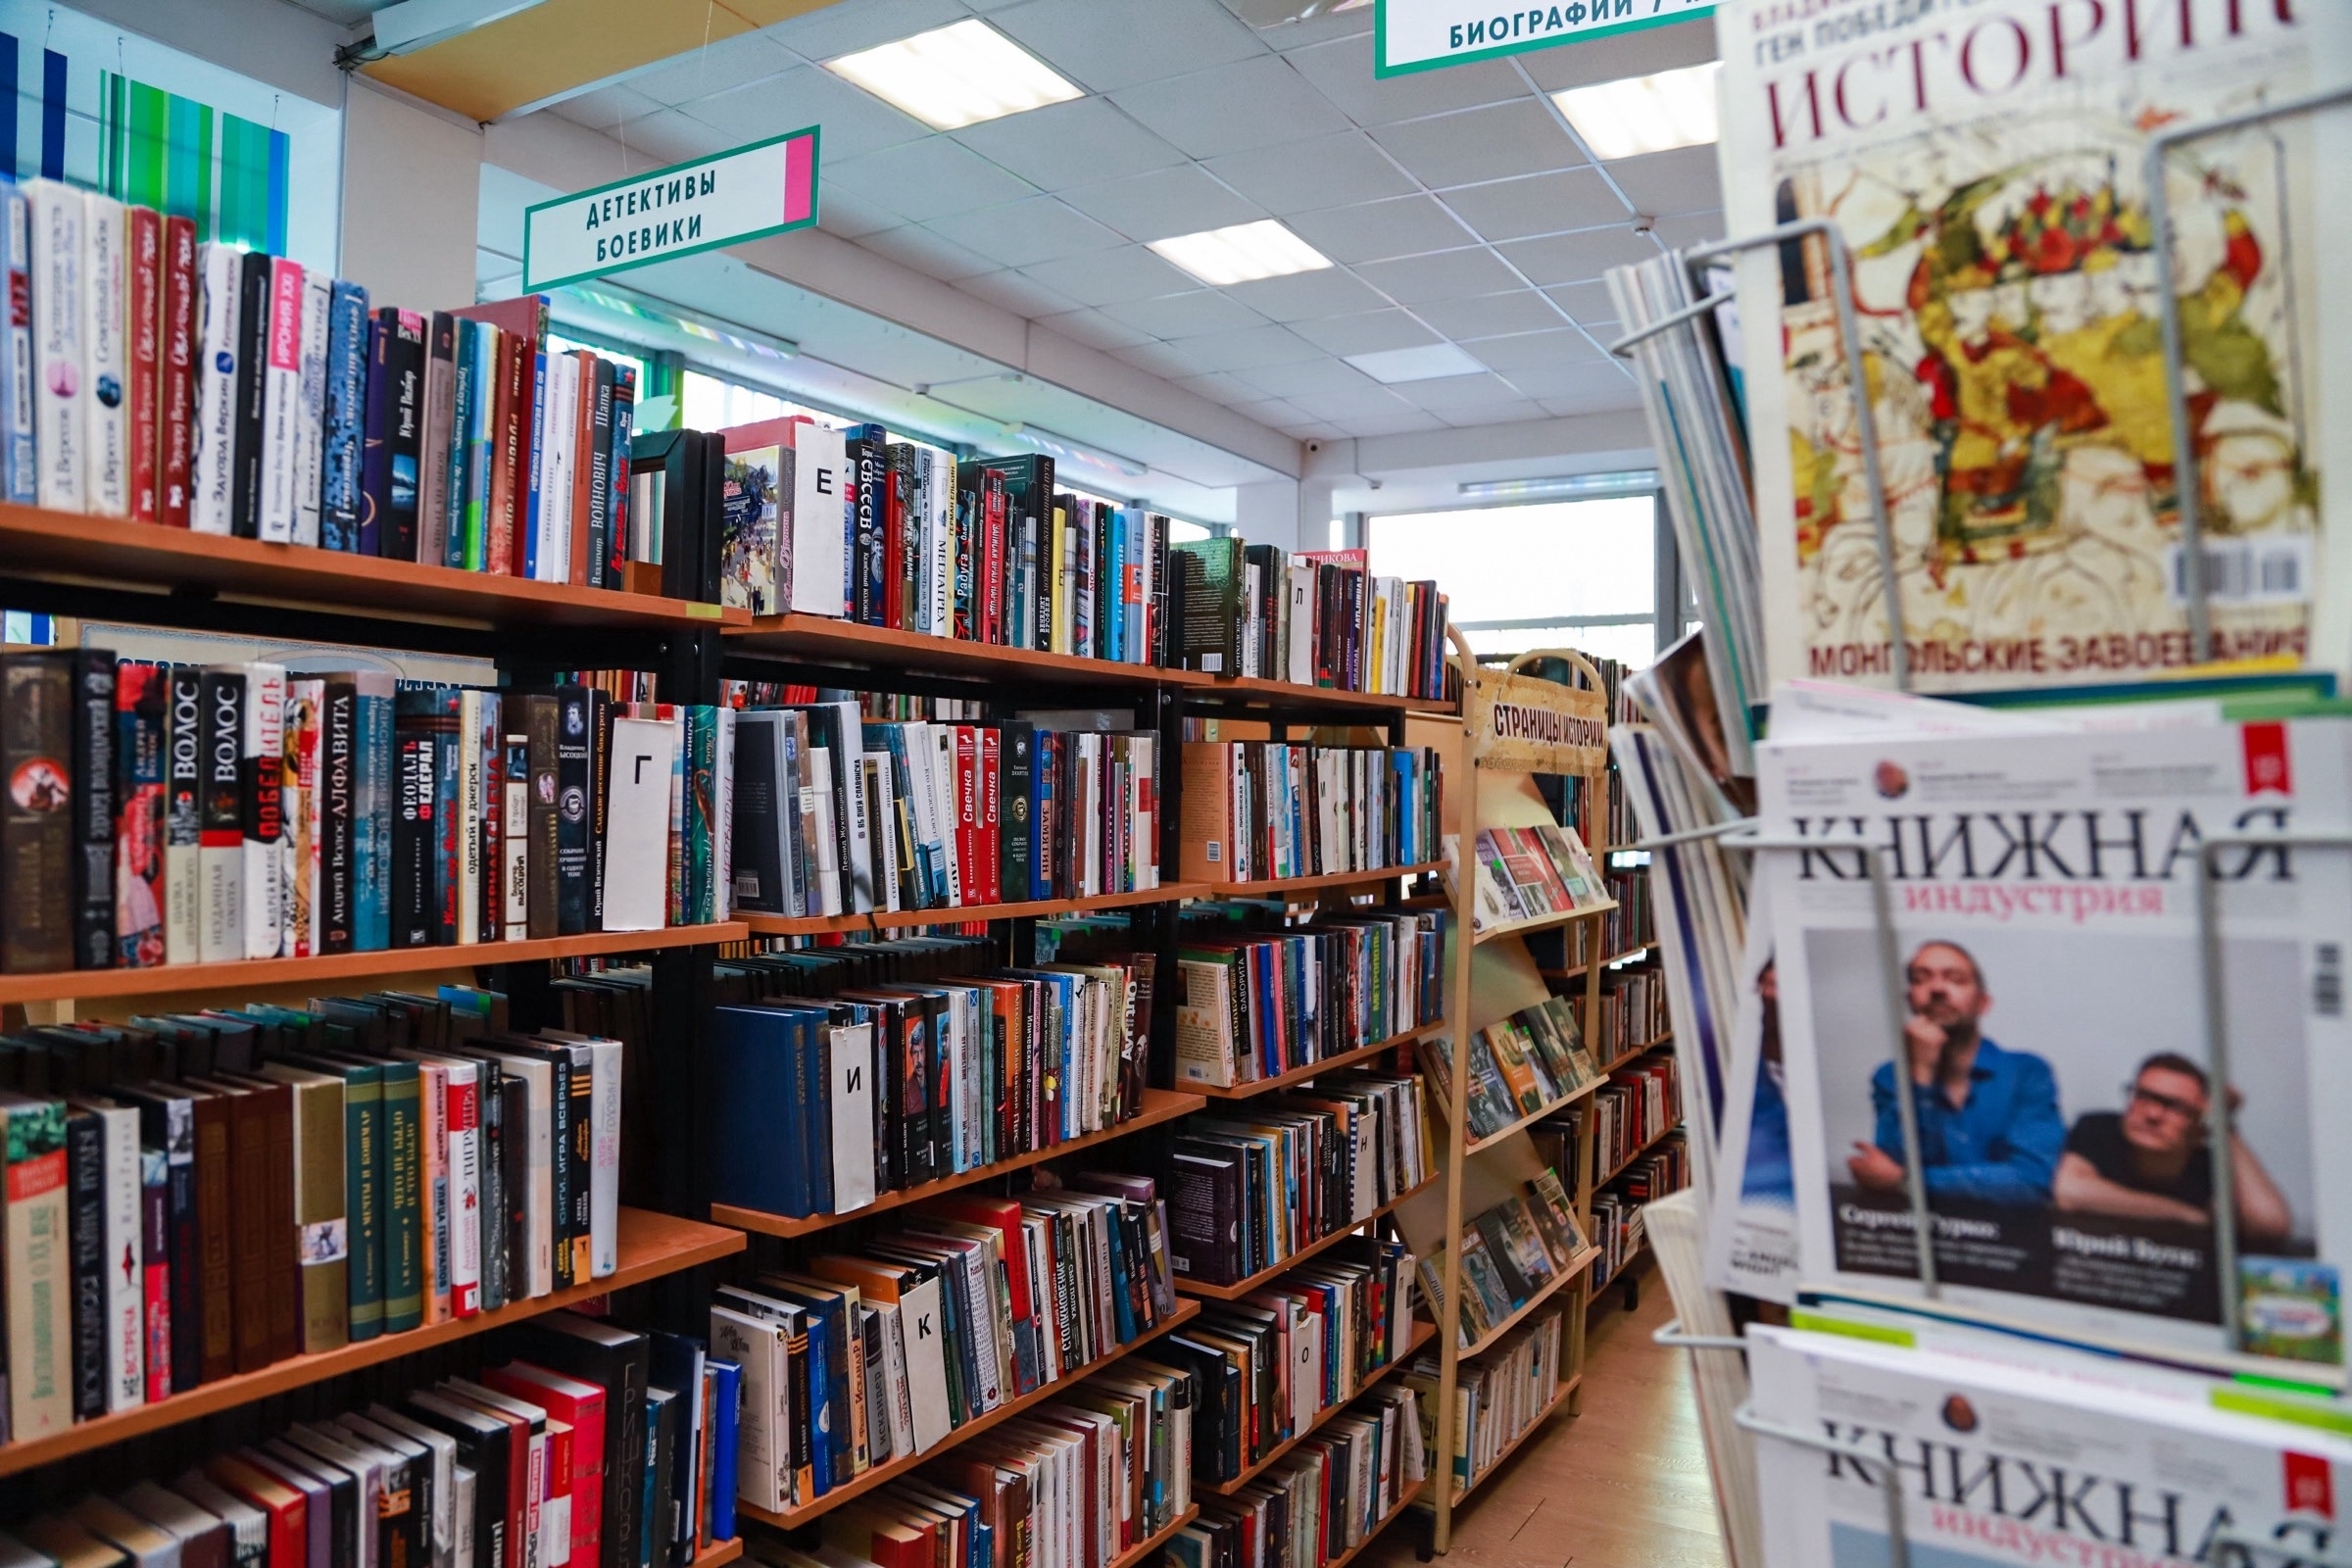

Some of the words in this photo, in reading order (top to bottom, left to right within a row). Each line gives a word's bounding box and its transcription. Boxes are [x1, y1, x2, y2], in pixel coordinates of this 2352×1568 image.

[1450, 0, 1632, 49] БИОГРАФИИ
[586, 170, 715, 230] ДЕТЕКТИВЫ
[597, 214, 702, 262] БОЕВИКИ
[275, 302, 292, 365] ИРОНИЯ
[536, 370, 544, 384] ВО
[214, 378, 229, 435] Веркин
[399, 408, 415, 438] Юрий
[532, 407, 542, 450] ВЕЛИКОЙ
[595, 384, 611, 428] Шапка
[213, 441, 228, 503] Эдуард
[530, 452, 539, 493] ПОБЕДЫ
[590, 452, 607, 529] ВОЙНОВИЧ
[816, 468, 833, 495] Е
[860, 459, 873, 530] ЕВСЕЕВ
[592, 538, 604, 584] Владимир
[991, 523, 1000, 559] ЗАПИСКИ
[956, 555, 969, 598] Радуга
[990, 561, 999, 583] ВРАГА
[989, 585, 998, 616] НАРОДА
[1809, 637, 2047, 678] МОНГОЛЬСКИЕ
[174, 681, 200, 779] ВОЛОС
[215, 686, 238, 782] ВОЛОС
[596, 704, 606, 753] баккуроты
[1494, 704, 1561, 747] СТРАНИЦЫ
[1563, 716, 1604, 748] ИСТОРИИ
[258, 676, 281, 837] ПОБЕДИТЕЛЬ
[331, 696, 349, 817] АЛФАВИТА
[635, 756, 653, 785] Г
[853, 759, 863, 799] СЛАВЯНСКА
[403, 741, 418, 820] ФЕОДАЛЪ
[417, 741, 433, 820] ФЕДЕРАЛ
[467, 763, 478, 811] джерси
[962, 769, 973, 823] Свечка
[987, 771, 996, 823] Свечка
[595, 796, 604, 834] Сладкие
[837, 786, 848, 838] Жуковицкий
[856, 800, 864, 817] ДНЕЙ
[858, 818, 865, 828] 85
[466, 827, 478, 875] одетый
[594, 840, 603, 887] Вяземский
[1791, 806, 2298, 881] КНИЖНАЯ
[516, 857, 525, 908] ВЫСОЦКИЙ
[594, 888, 603, 916] Юрий
[951, 861, 960, 898] ЗАГУЛ
[1903, 882, 2165, 923] индустрия
[1238, 956, 1248, 1012] ФАВОРИТА
[1231, 998, 1240, 1037] ВОЛКИ
[558, 1062, 566, 1130] ВСЕРЬЕЗ
[846, 1066, 862, 1094] И
[1360, 1136, 1368, 1152] Н
[361, 1183, 371, 1226] МЕЧТЫ
[436, 1183, 447, 1222] УЛИЦА
[437, 1225, 448, 1288] ГЕНЕРАЛОВ
[918, 1313, 931, 1340] К
[1056, 1260, 1072, 1351] СТОЛКНОВЕНИЕ
[1301, 1347, 1309, 1363] О
[874, 1371, 887, 1446] искандер
[648, 1439, 657, 1466] Реки
